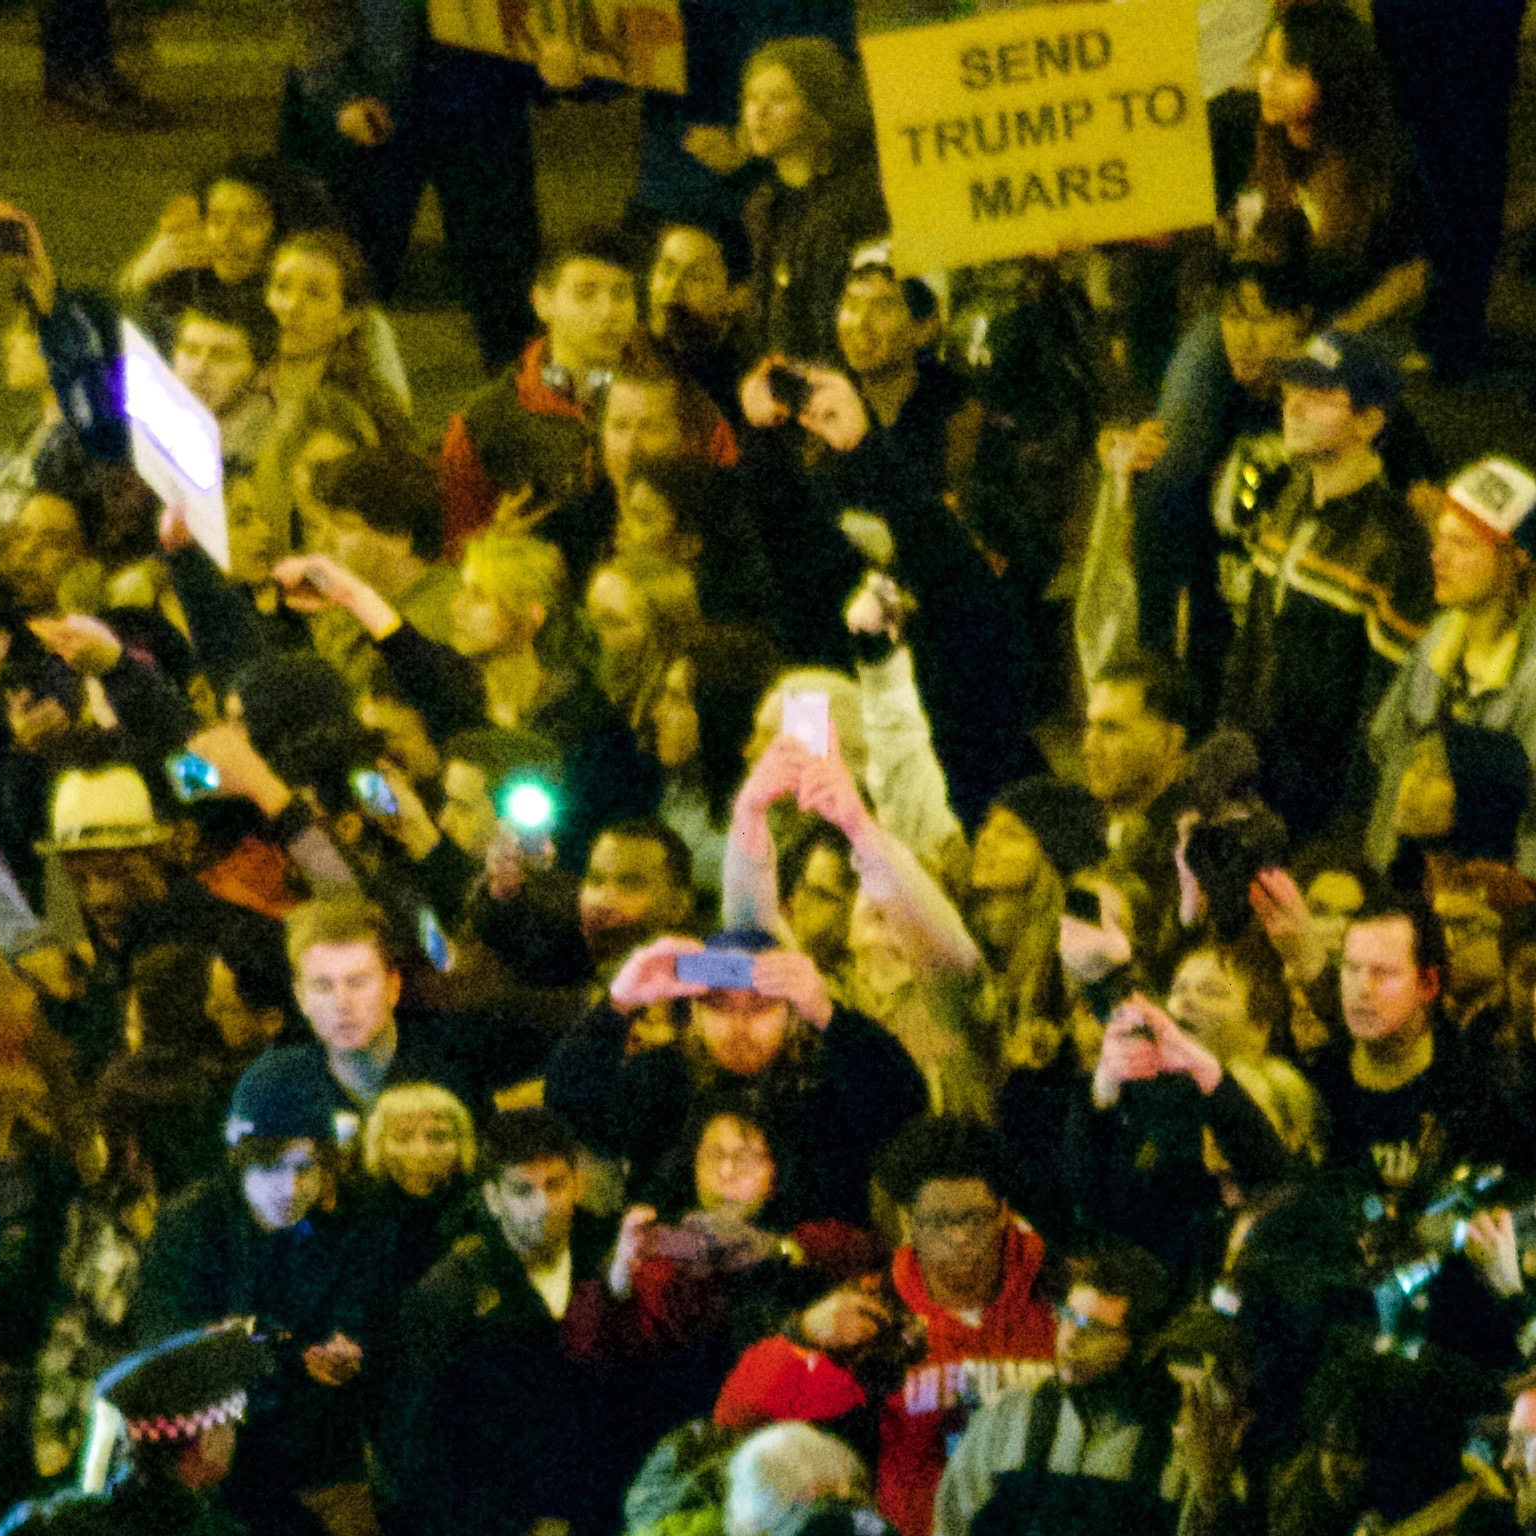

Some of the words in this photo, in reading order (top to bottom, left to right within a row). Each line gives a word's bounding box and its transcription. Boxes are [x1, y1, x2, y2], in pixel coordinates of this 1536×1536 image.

[960, 29, 1113, 90] SEND
[900, 98, 1094, 166] TRUMP
[1110, 83, 1187, 133] TO
[969, 158, 1132, 224] MARS
